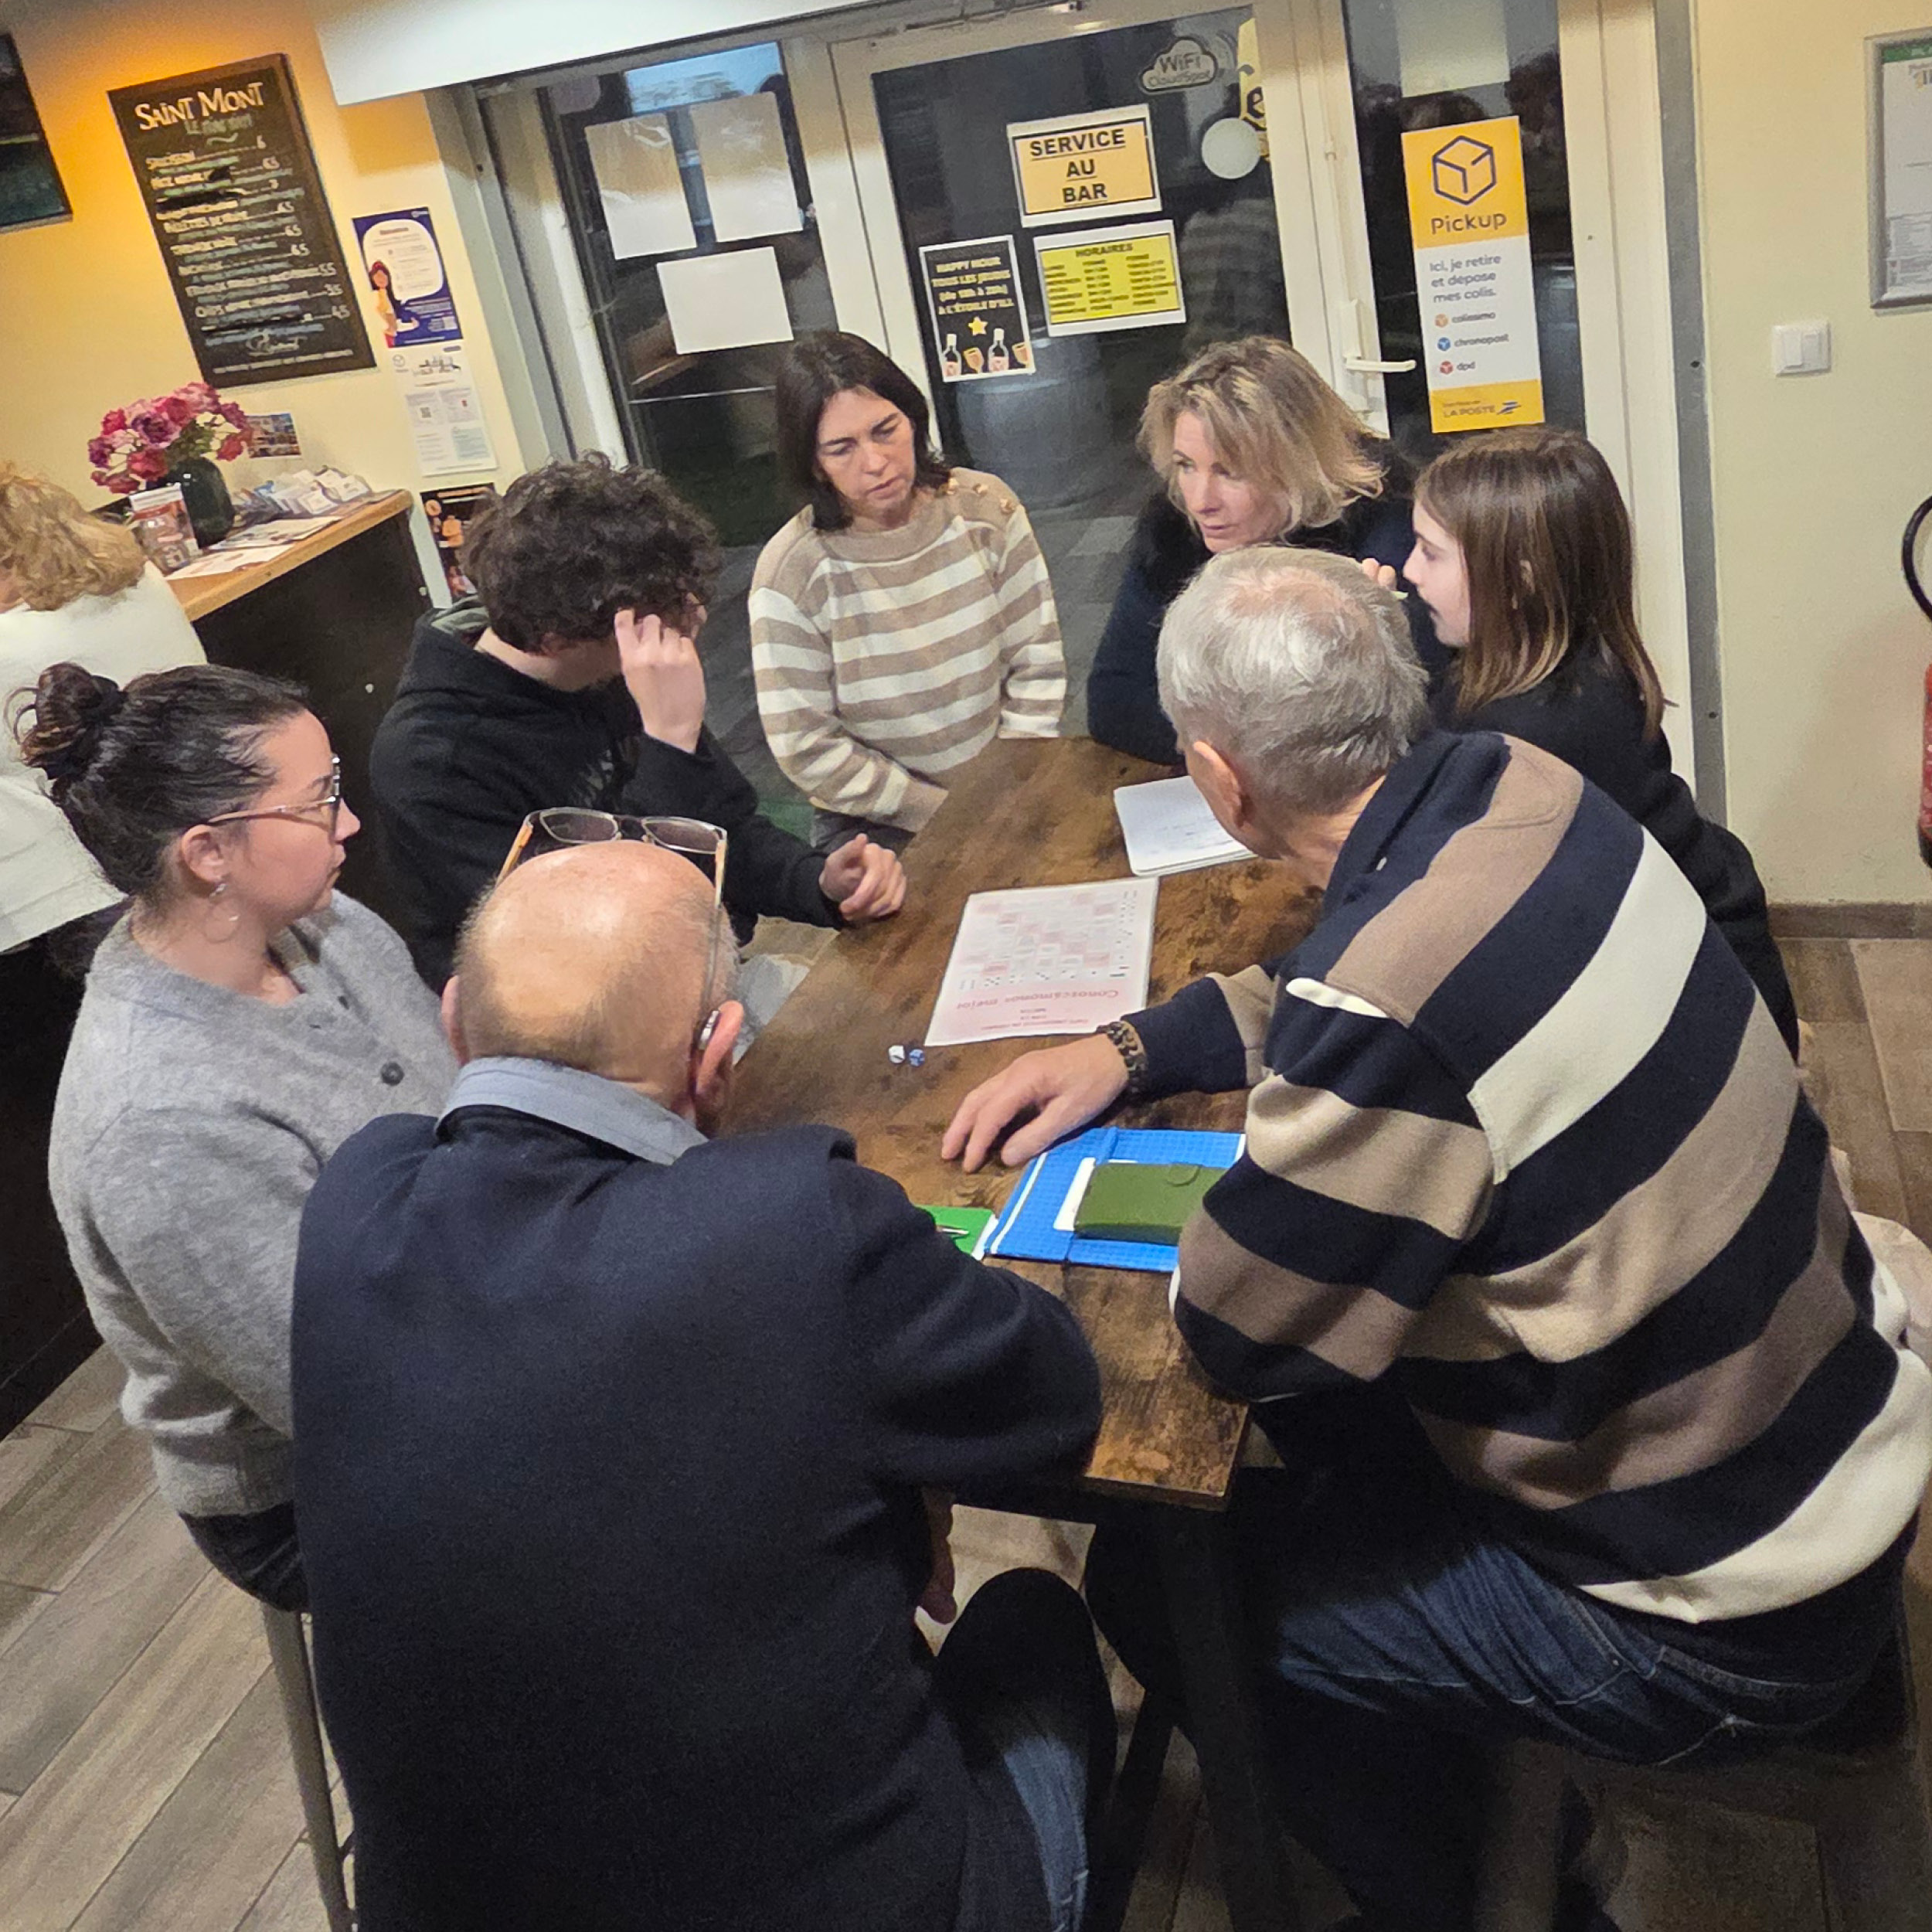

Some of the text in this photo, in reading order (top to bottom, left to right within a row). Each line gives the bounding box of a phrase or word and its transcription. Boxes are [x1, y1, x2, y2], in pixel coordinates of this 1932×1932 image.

[198, 82, 264, 117] MONT
[1029, 128, 1125, 156] SERVICE
[1066, 159, 1096, 178] AU
[1062, 183, 1107, 203] BAR
[1430, 213, 1508, 235] Pickup
[1075, 243, 1134, 257] HORAIRES
[1451, 258, 1463, 273] je
[1465, 253, 1502, 267] retire
[1430, 277, 1445, 288] et
[1434, 292, 1462, 304] mes
[1454, 333, 1509, 348] chronopost
[1456, 361, 1476, 372] dpd
[1443, 404, 1496, 418] LA POSTE
